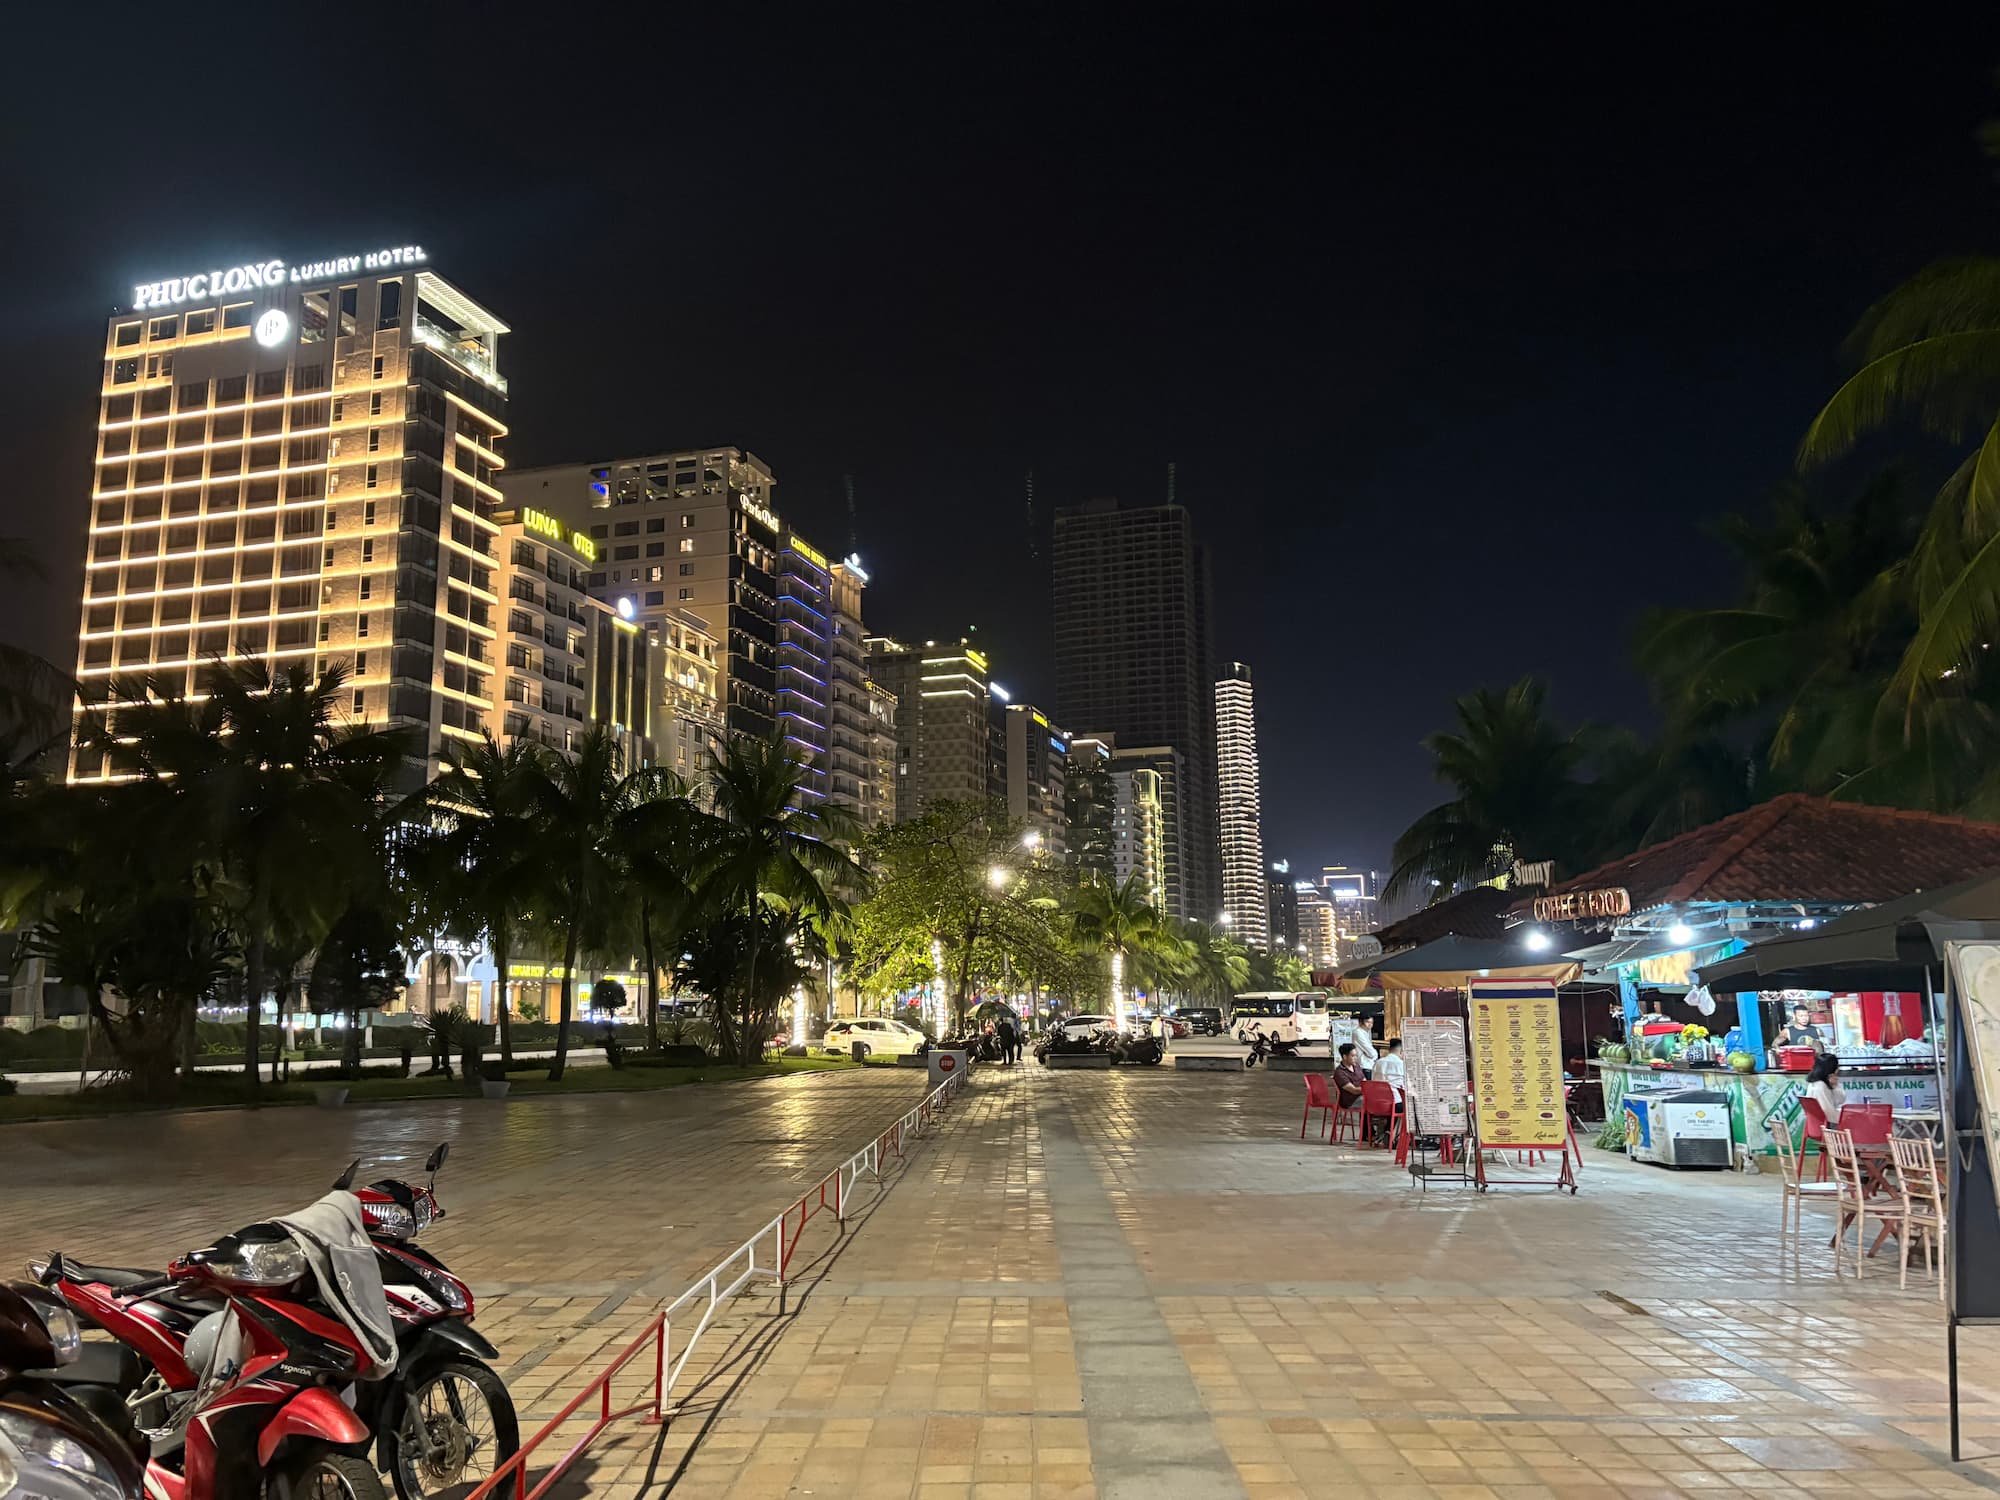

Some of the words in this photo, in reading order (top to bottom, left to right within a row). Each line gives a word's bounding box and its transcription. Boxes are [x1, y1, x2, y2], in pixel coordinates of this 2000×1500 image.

[133, 277, 208, 309] PHUC
[209, 260, 286, 297] LONG
[290, 255, 360, 281] LUXURY
[365, 246, 426, 268] HOTEL
[523, 507, 559, 540] LUNA
[1513, 858, 1555, 889] Sunny
[1533, 894, 1575, 921] COFFEE
[1588, 888, 1629, 917] FOOD
[940, 1060, 954, 1068] STOP
[280, 1363, 312, 1377] HONDA
